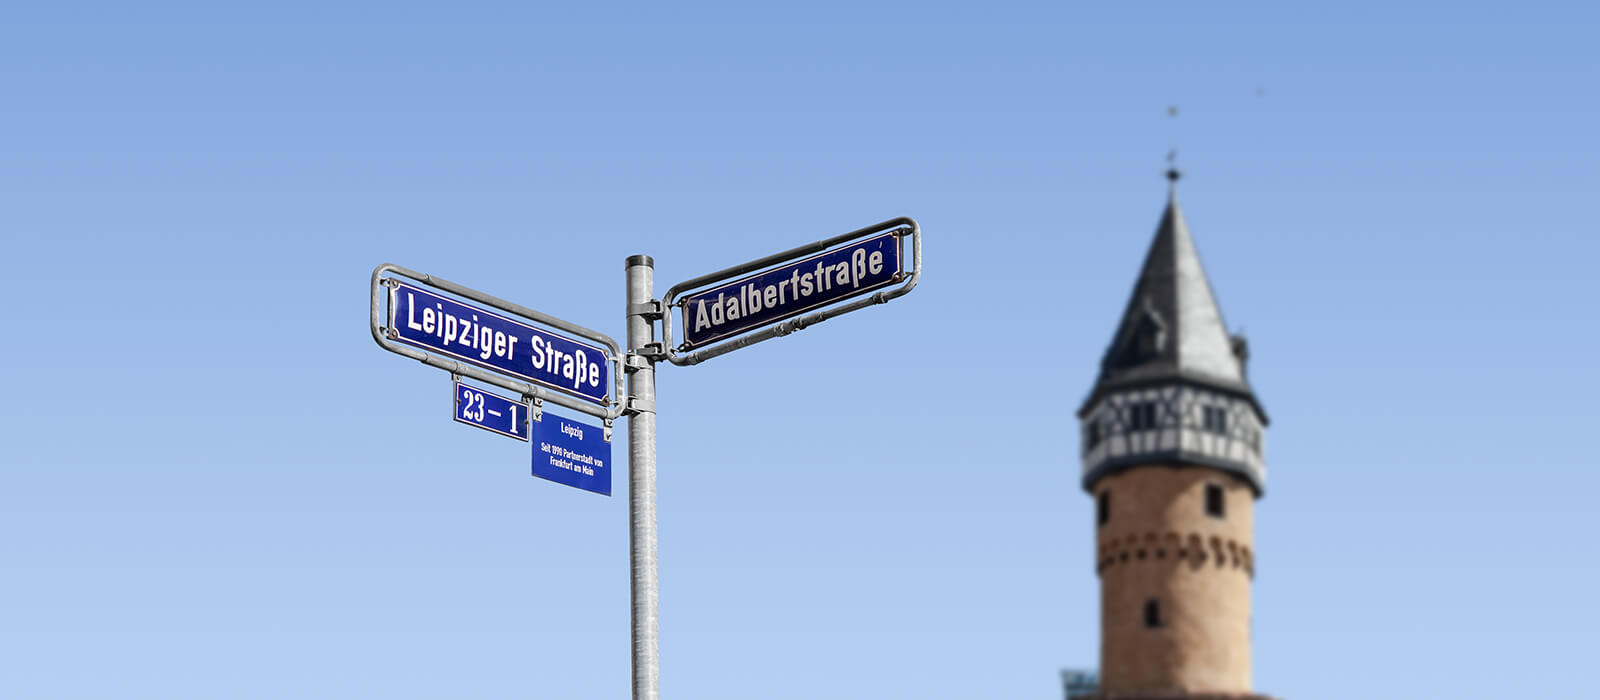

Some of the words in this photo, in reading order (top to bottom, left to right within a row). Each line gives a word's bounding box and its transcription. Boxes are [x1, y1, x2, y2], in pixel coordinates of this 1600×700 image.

[694, 247, 883, 333] Adalbertstraße
[407, 292, 518, 361] Leipziger
[531, 335, 600, 389] Straße
[463, 390, 485, 422] 23
[509, 405, 518, 433] 1
[560, 421, 584, 441] Leipzig
[541, 442, 551, 453] Seit
[563, 448, 593, 465] Partnerstadt
[594, 458, 603, 467] von
[550, 456, 573, 470] Frankfurt
[583, 464, 594, 476] Main
